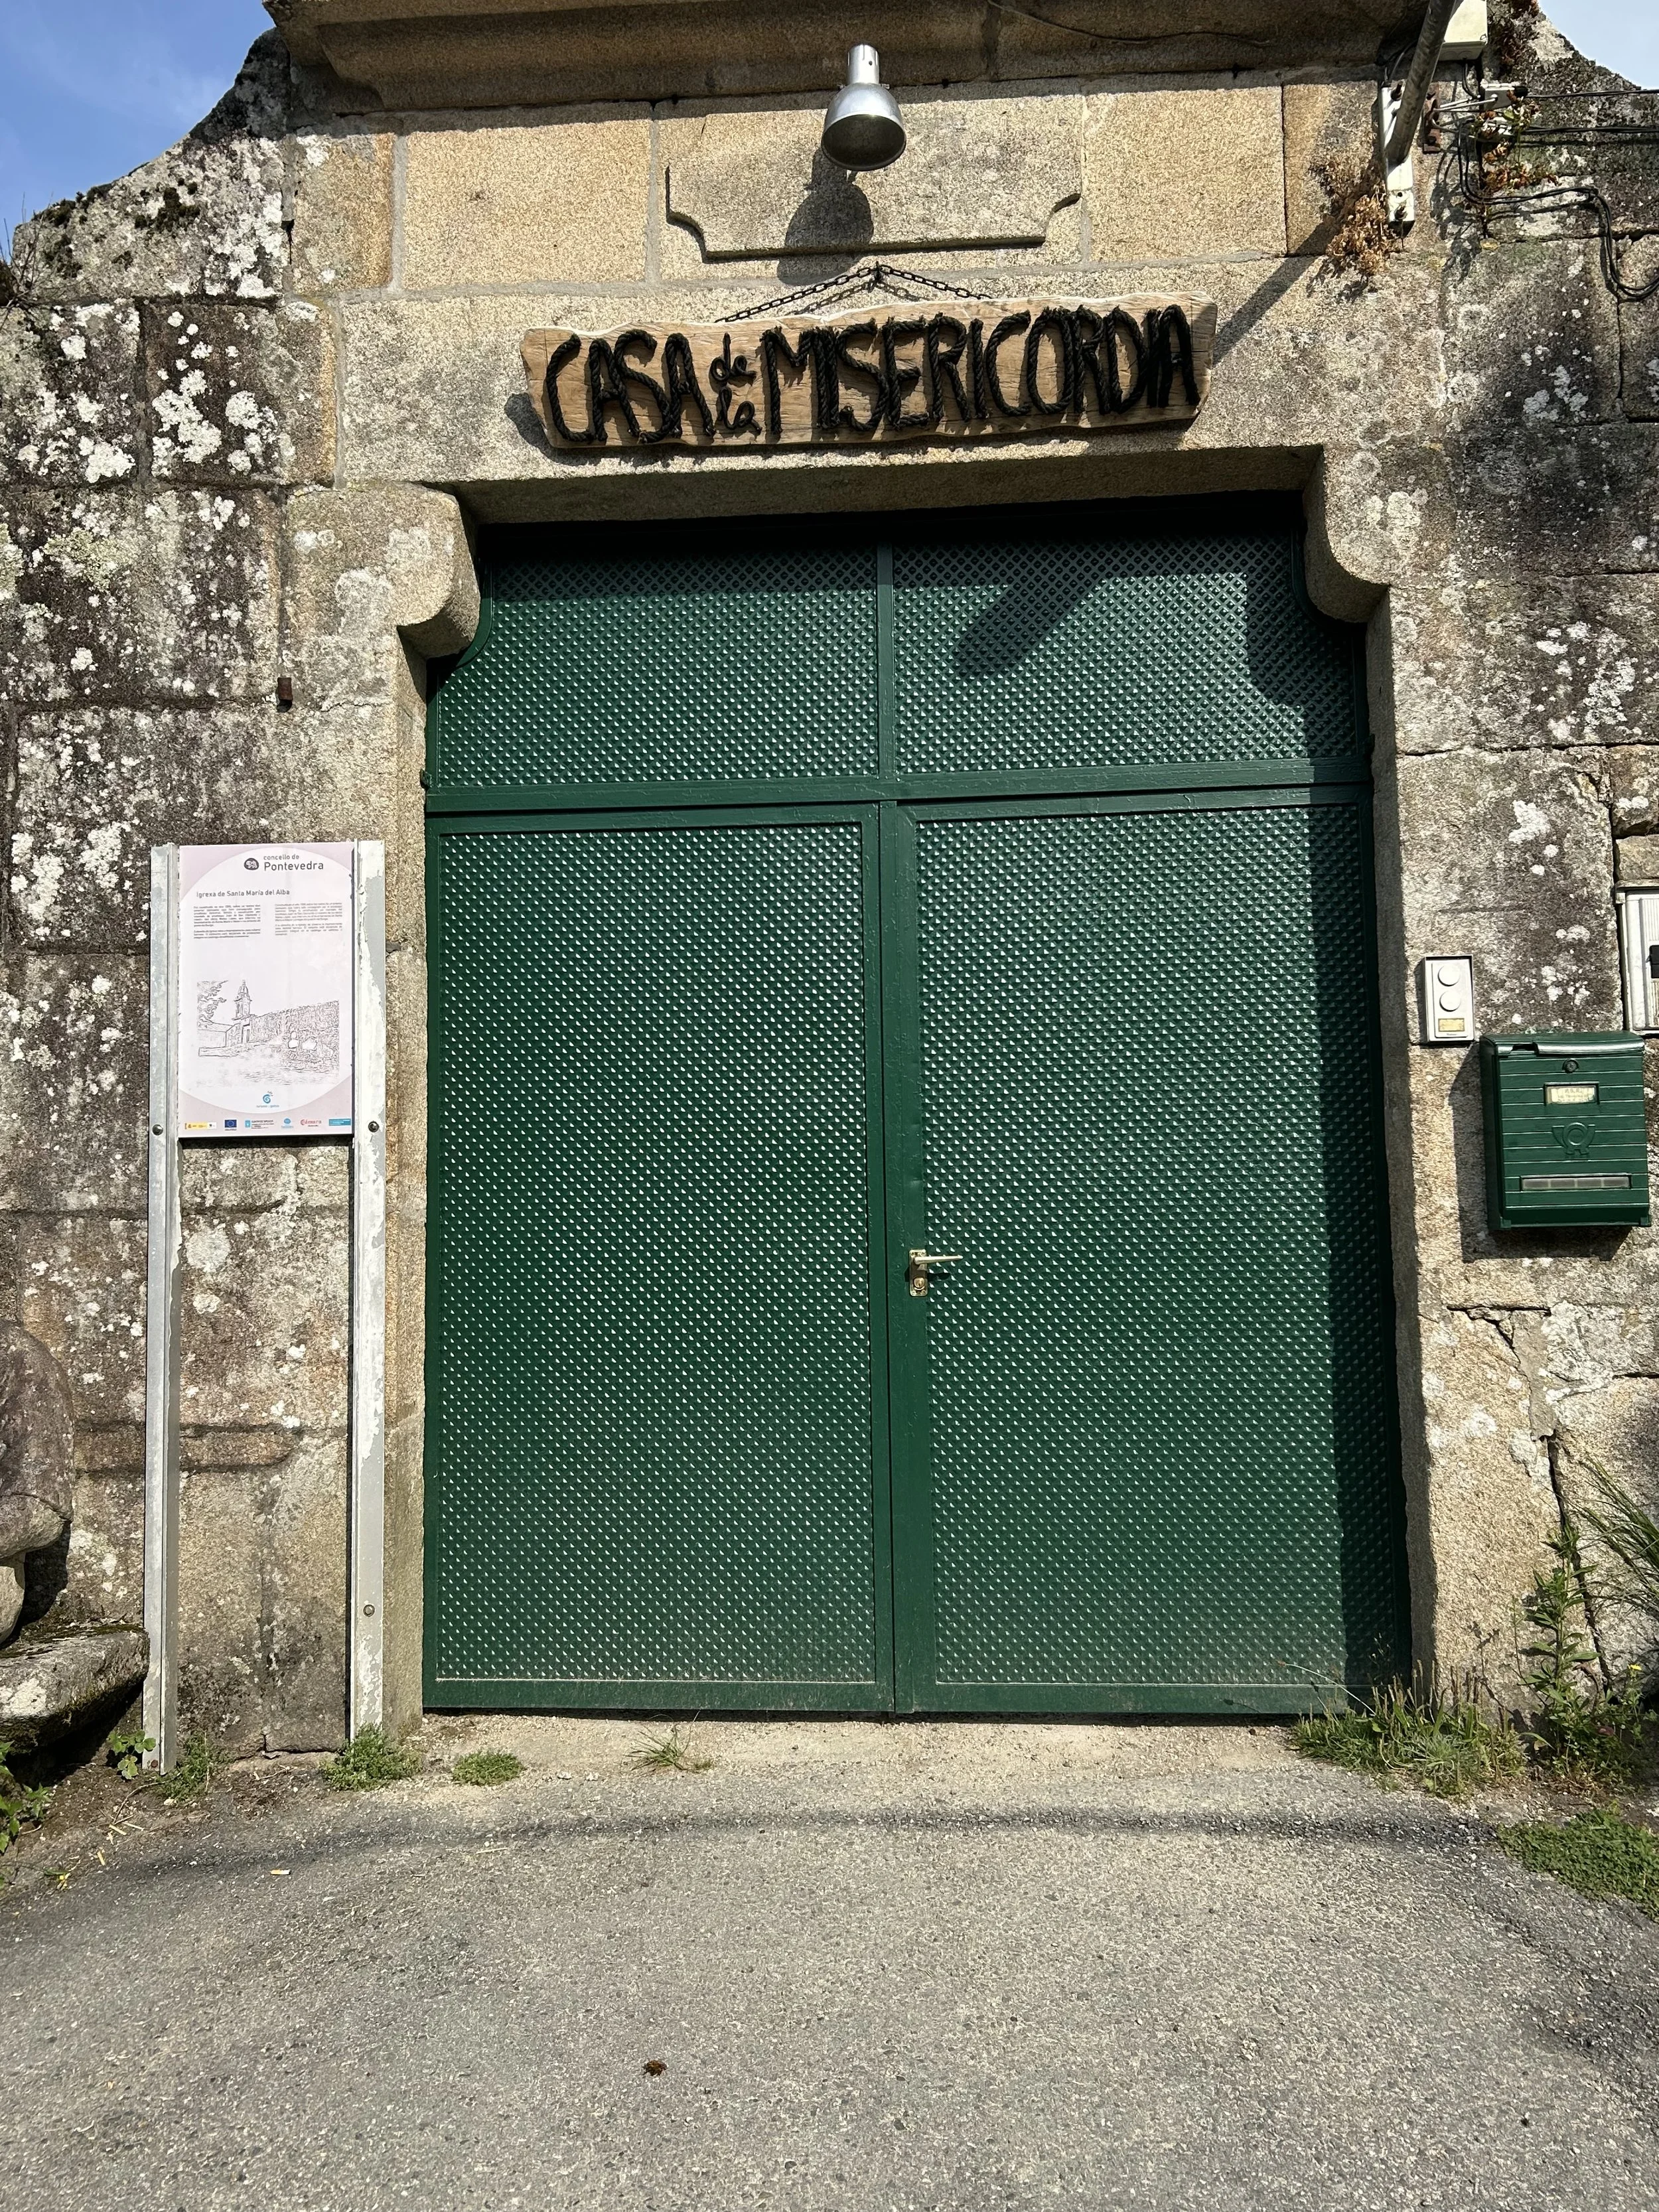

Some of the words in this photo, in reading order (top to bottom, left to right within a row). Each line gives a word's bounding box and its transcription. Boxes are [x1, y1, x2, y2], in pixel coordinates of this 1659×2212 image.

[546, 330, 716, 443] CASA
[711, 332, 757, 382] de
[760, 304, 1202, 435] MISERICORDIA
[264, 861, 324, 871] Pontevedra
